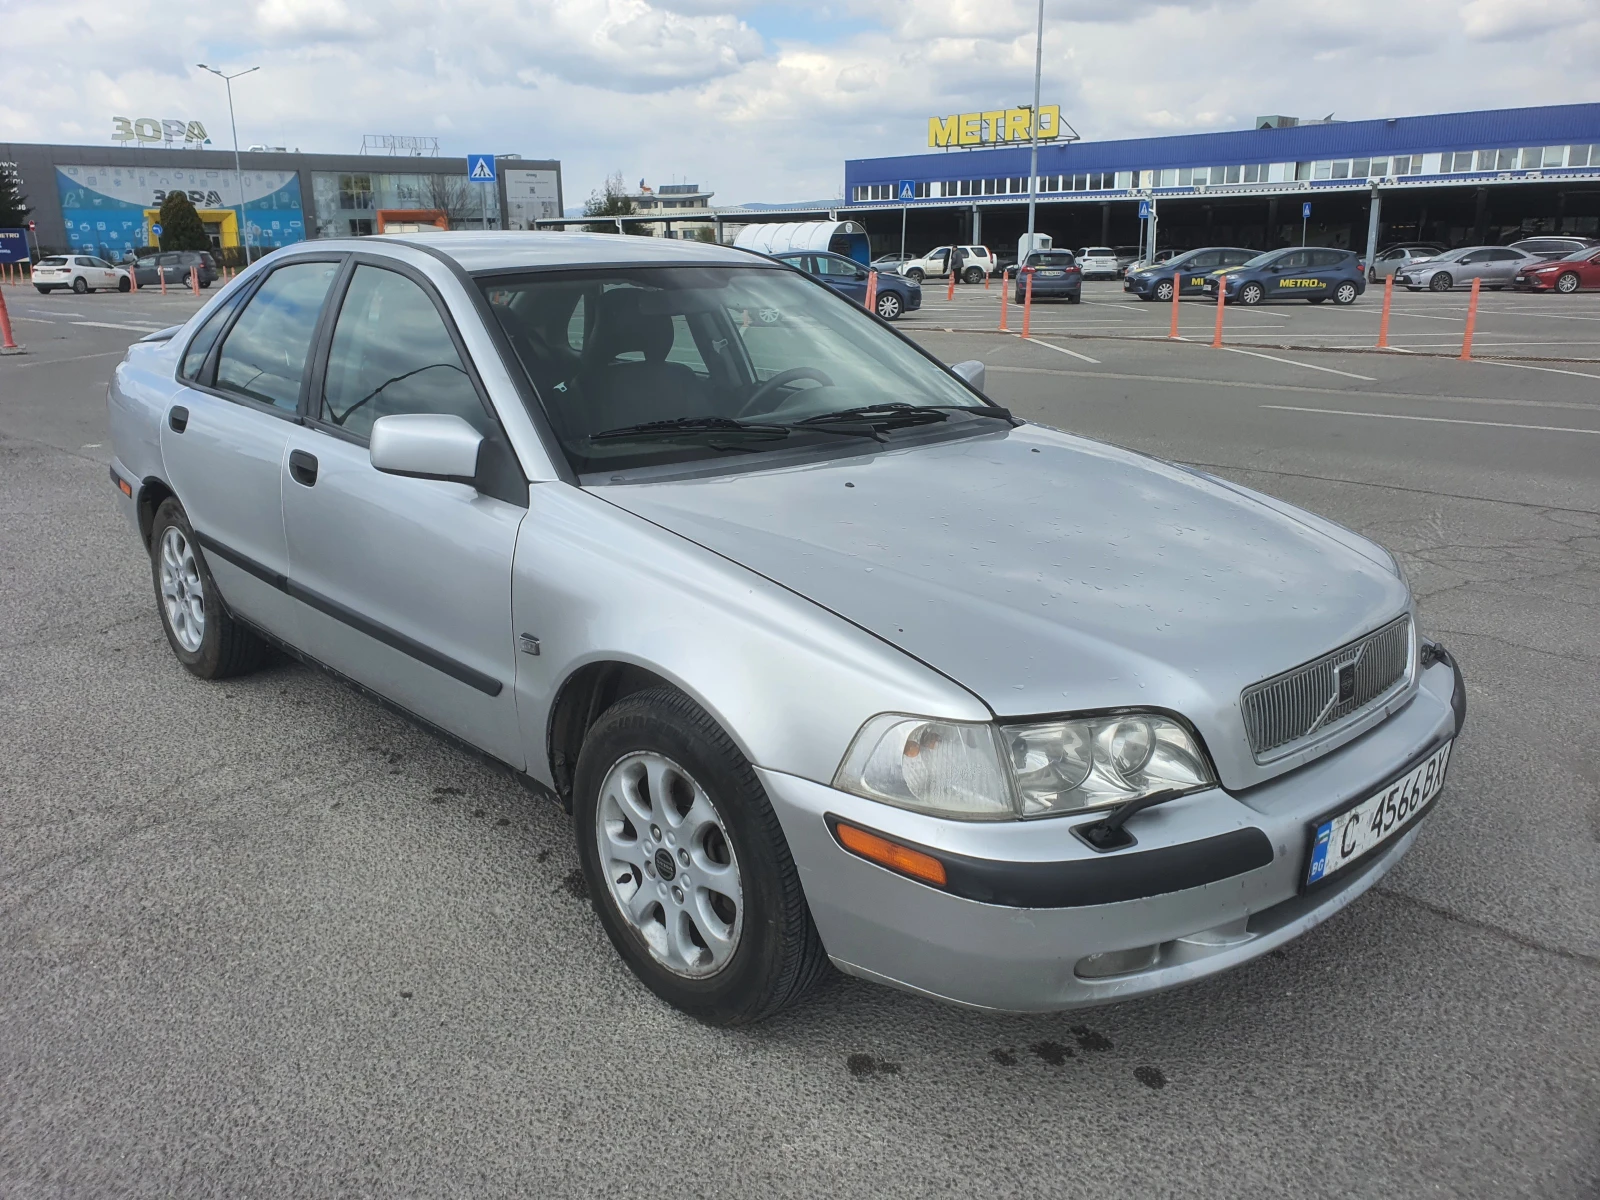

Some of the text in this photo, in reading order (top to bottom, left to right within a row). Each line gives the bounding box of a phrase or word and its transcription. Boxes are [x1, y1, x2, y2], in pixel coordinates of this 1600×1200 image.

[111, 116, 208, 143] ЗОРА
[928, 105, 1060, 147] METRO
[1280, 279, 1327, 289] METRO.bg
[1341, 814, 1360, 859] C
[1311, 859, 1325, 876] BG
